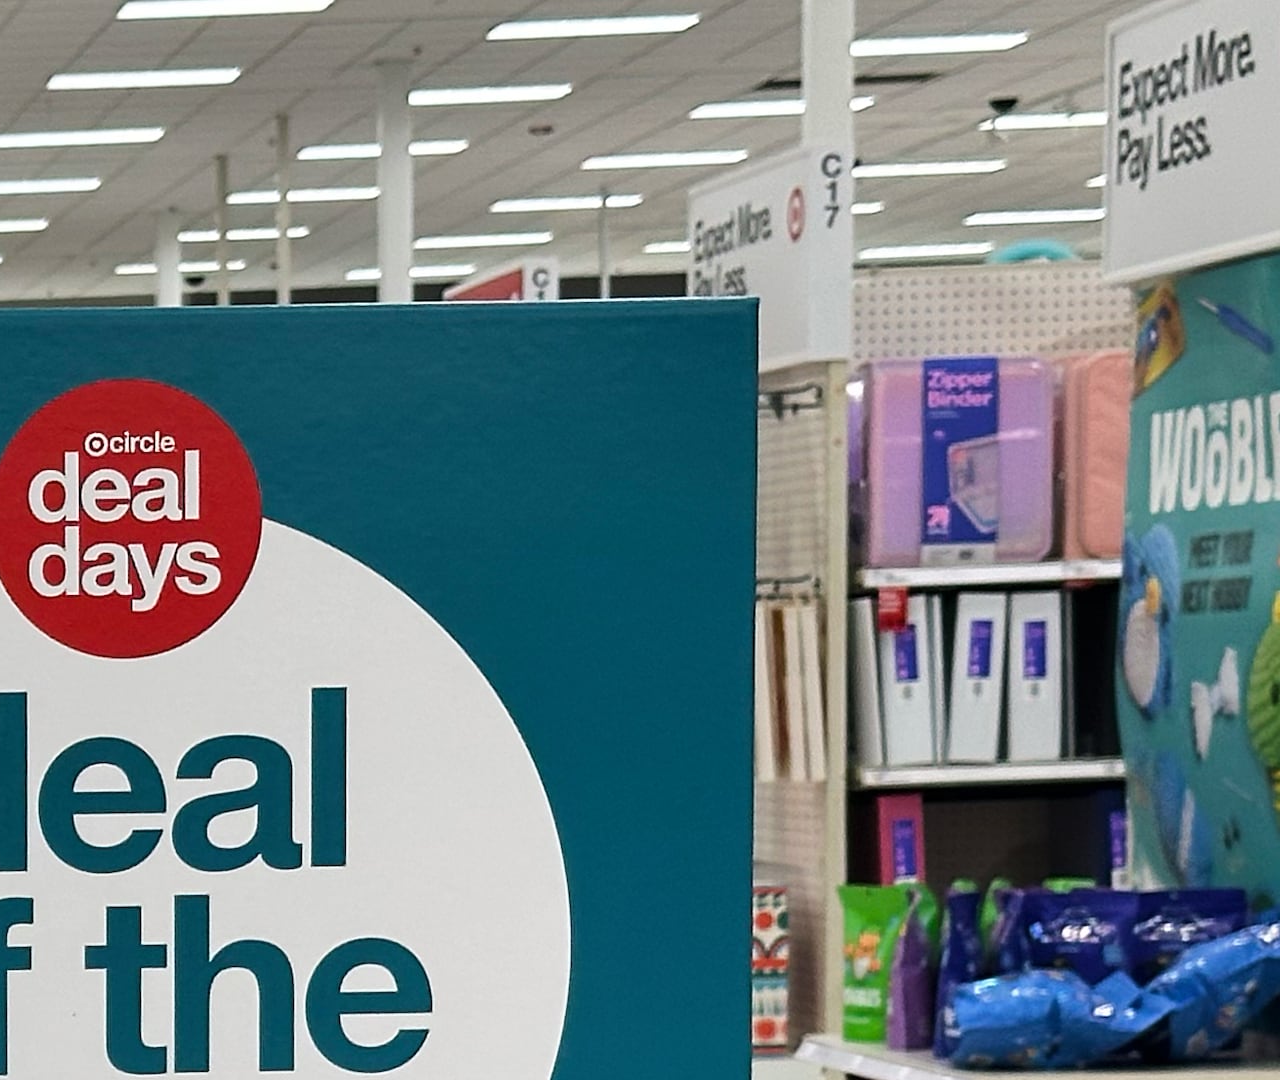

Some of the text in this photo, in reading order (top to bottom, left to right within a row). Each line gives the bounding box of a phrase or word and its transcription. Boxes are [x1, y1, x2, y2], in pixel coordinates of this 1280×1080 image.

[1118, 41, 1189, 125] Expect
[1116, 128, 1153, 191] Pay
[927, 368, 993, 390] Zipper
[927, 389, 994, 408] Binder
[110, 431, 175, 453] circle
[28, 449, 200, 523] deal
[28, 525, 222, 613] days
[83, 894, 434, 1077] the
